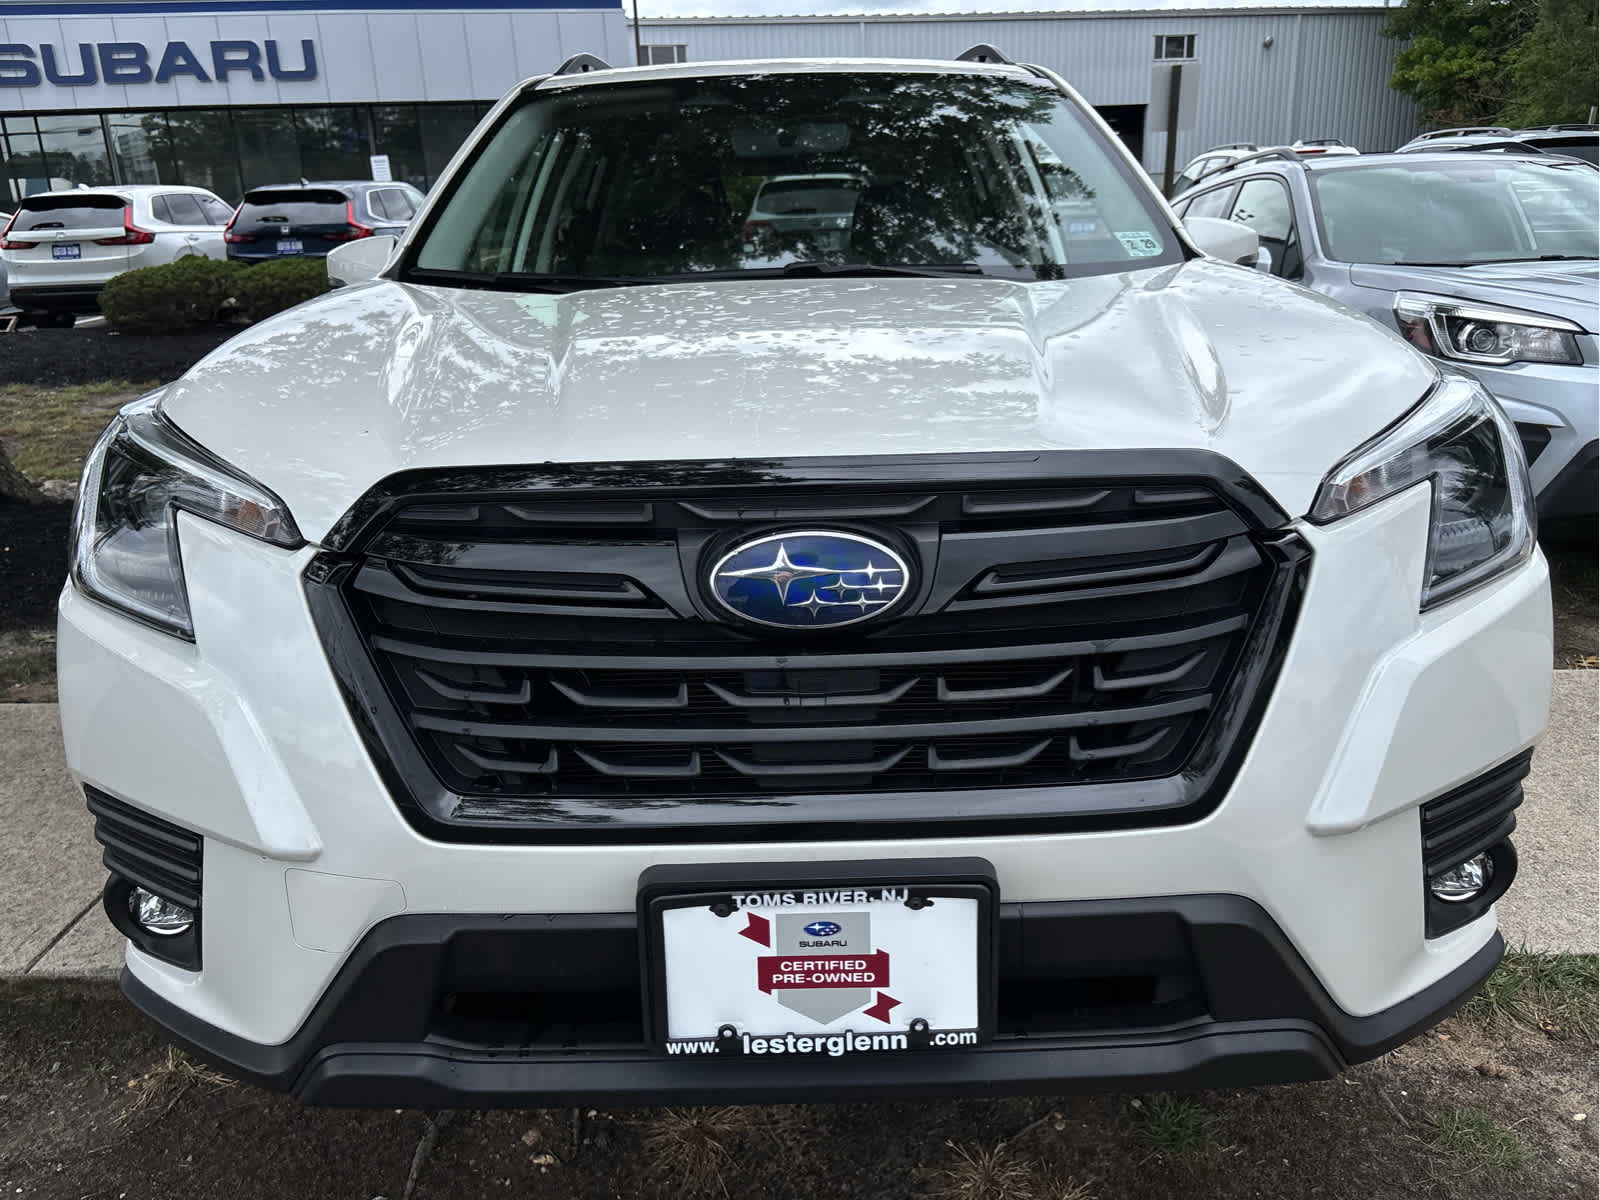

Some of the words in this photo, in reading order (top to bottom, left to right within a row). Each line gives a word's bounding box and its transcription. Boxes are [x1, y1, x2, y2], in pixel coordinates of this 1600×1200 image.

[0, 39, 318, 87] SUBARU
[732, 894, 796, 908] TOMS
[881, 888, 909, 902] NJ
[799, 940, 848, 948] SUBARU
[780, 960, 867, 972] CERTIFIED
[772, 972, 875, 984] PRE-OWNED
[666, 1040, 719, 1055] www.
[743, 1032, 908, 1056] lesterglenn
